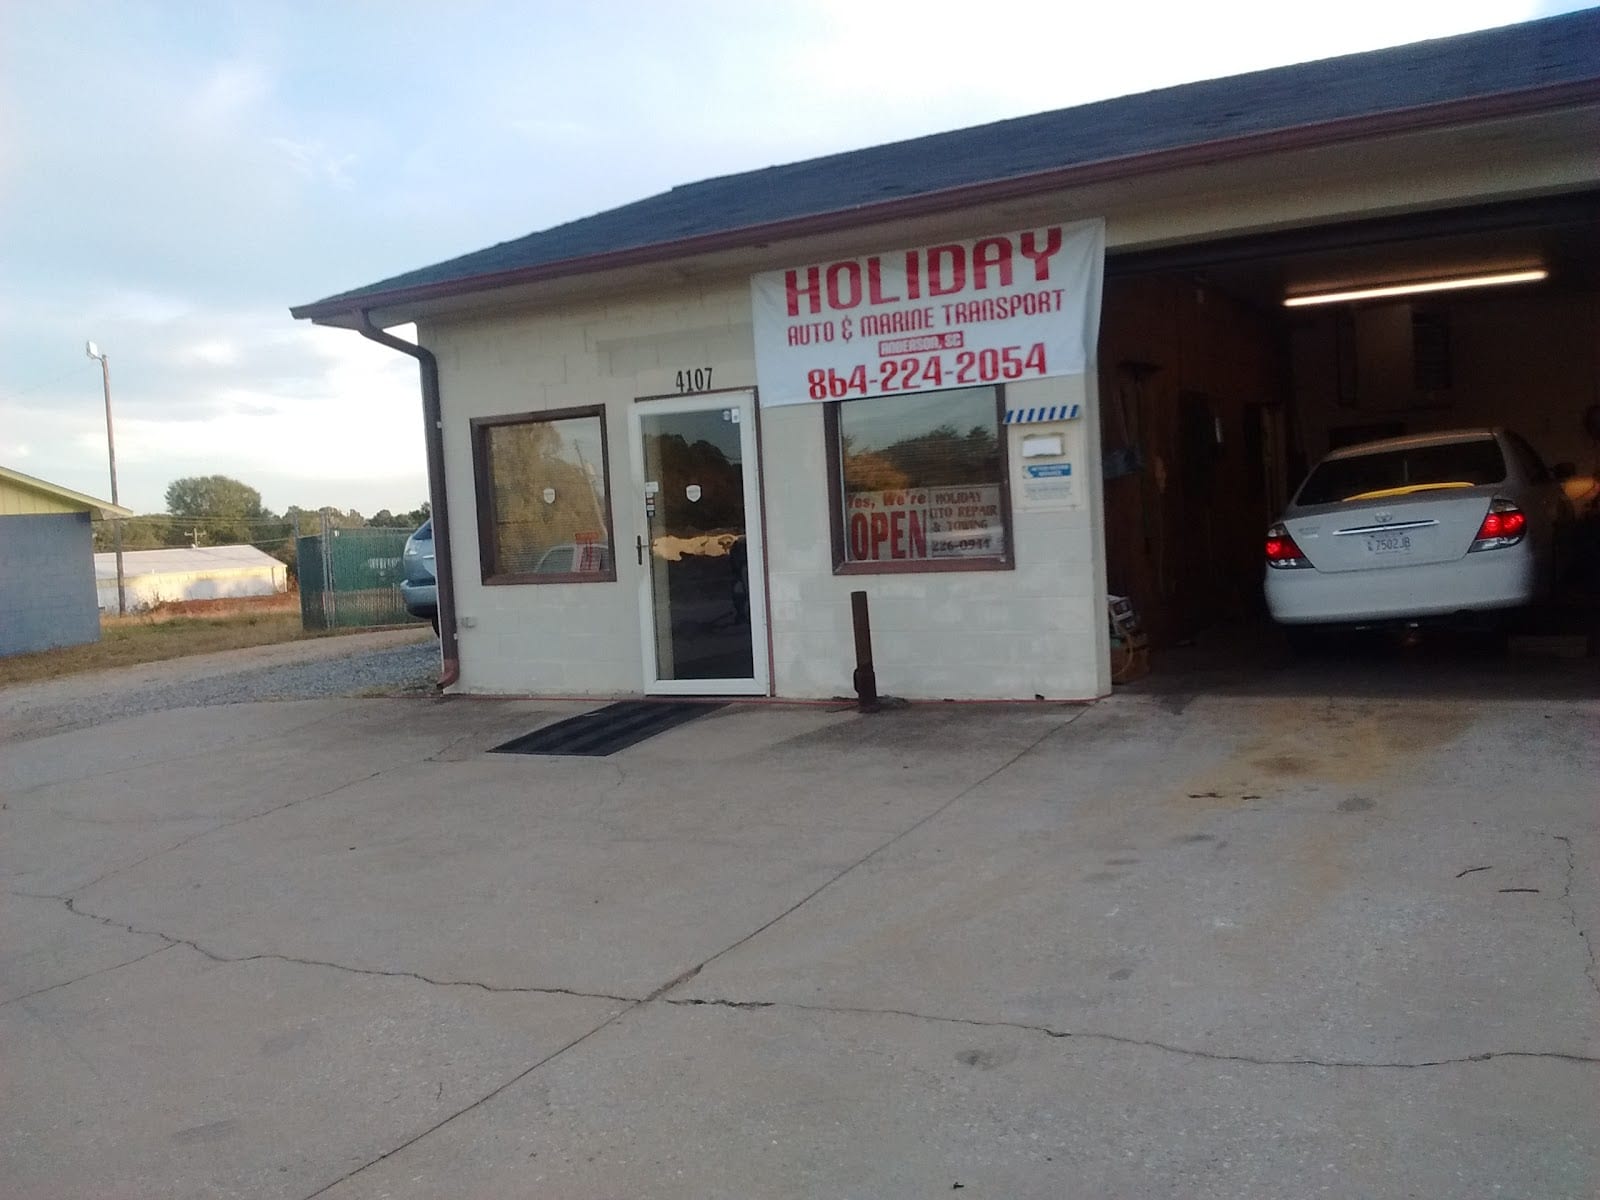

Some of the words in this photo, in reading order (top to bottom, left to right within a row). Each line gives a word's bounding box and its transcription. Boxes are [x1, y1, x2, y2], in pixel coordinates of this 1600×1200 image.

[784, 227, 1063, 317] HOLIDAY
[787, 321, 835, 347] AUTO
[842, 315, 853, 343] &
[861, 307, 934, 338] MARINE
[944, 288, 1066, 325] TRANSPORT
[675, 367, 713, 393] 4107
[807, 342, 1047, 400] 864-224-2054
[847, 494, 876, 510] Yes,
[883, 490, 927, 506] We're
[935, 491, 981, 505] HOLIDAY
[929, 507, 953, 519] UTO
[958, 505, 997, 517] REPAIR
[946, 519, 988, 531] TOWING
[851, 509, 927, 561] OPEN
